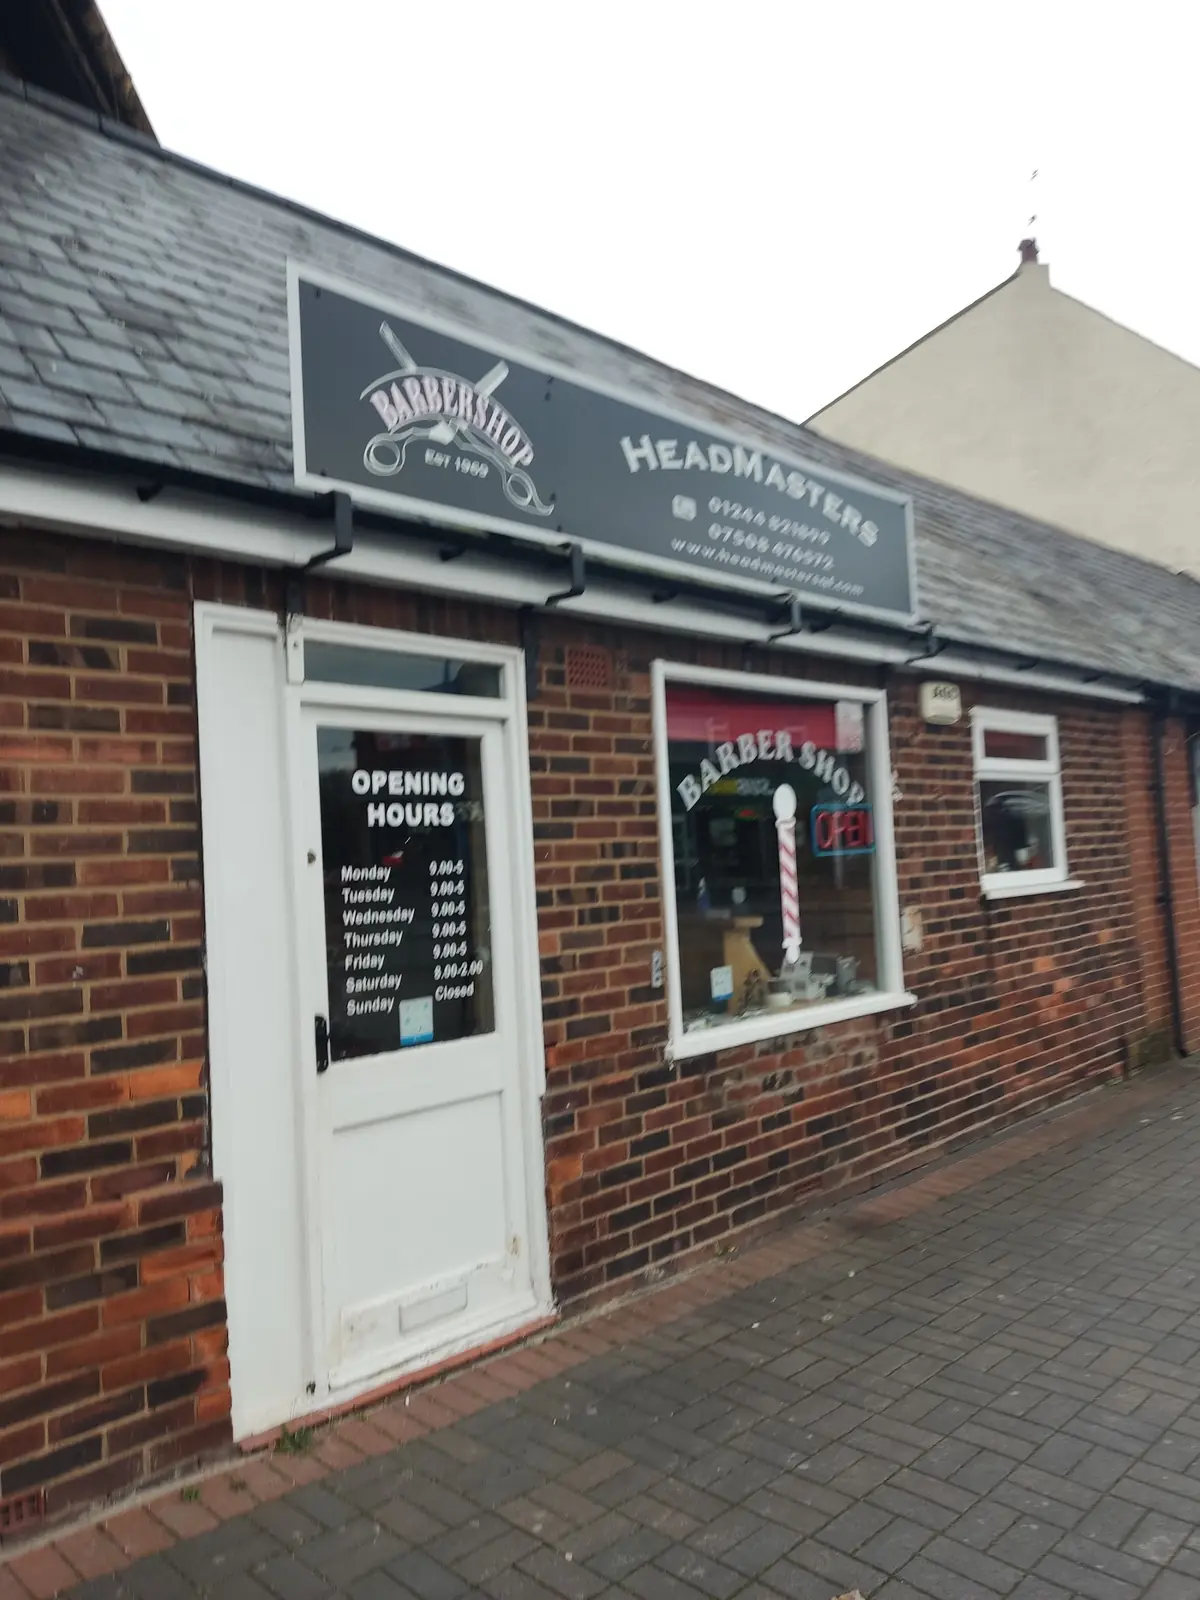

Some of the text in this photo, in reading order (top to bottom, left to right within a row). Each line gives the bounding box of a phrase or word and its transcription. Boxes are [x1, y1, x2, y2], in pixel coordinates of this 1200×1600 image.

[370, 376, 534, 467] BARBERSHOP
[620, 435, 880, 547] HEADMASTERS
[351, 769, 465, 796] OPENING
[676, 730, 865, 812] BARBER SHOP
[367, 802, 455, 827] HOURS
[341, 859, 464, 883] Monday 9.00-5
[342, 880, 465, 905] Tuesday 9.00-5
[343, 900, 466, 927] Wednesday 9.00-5
[344, 920, 466, 950] Thursday 9.00-5
[345, 941, 468, 972] Friday 9.00-5
[346, 972, 402, 994] Saturday
[347, 981, 475, 1017] Sunday Closed
